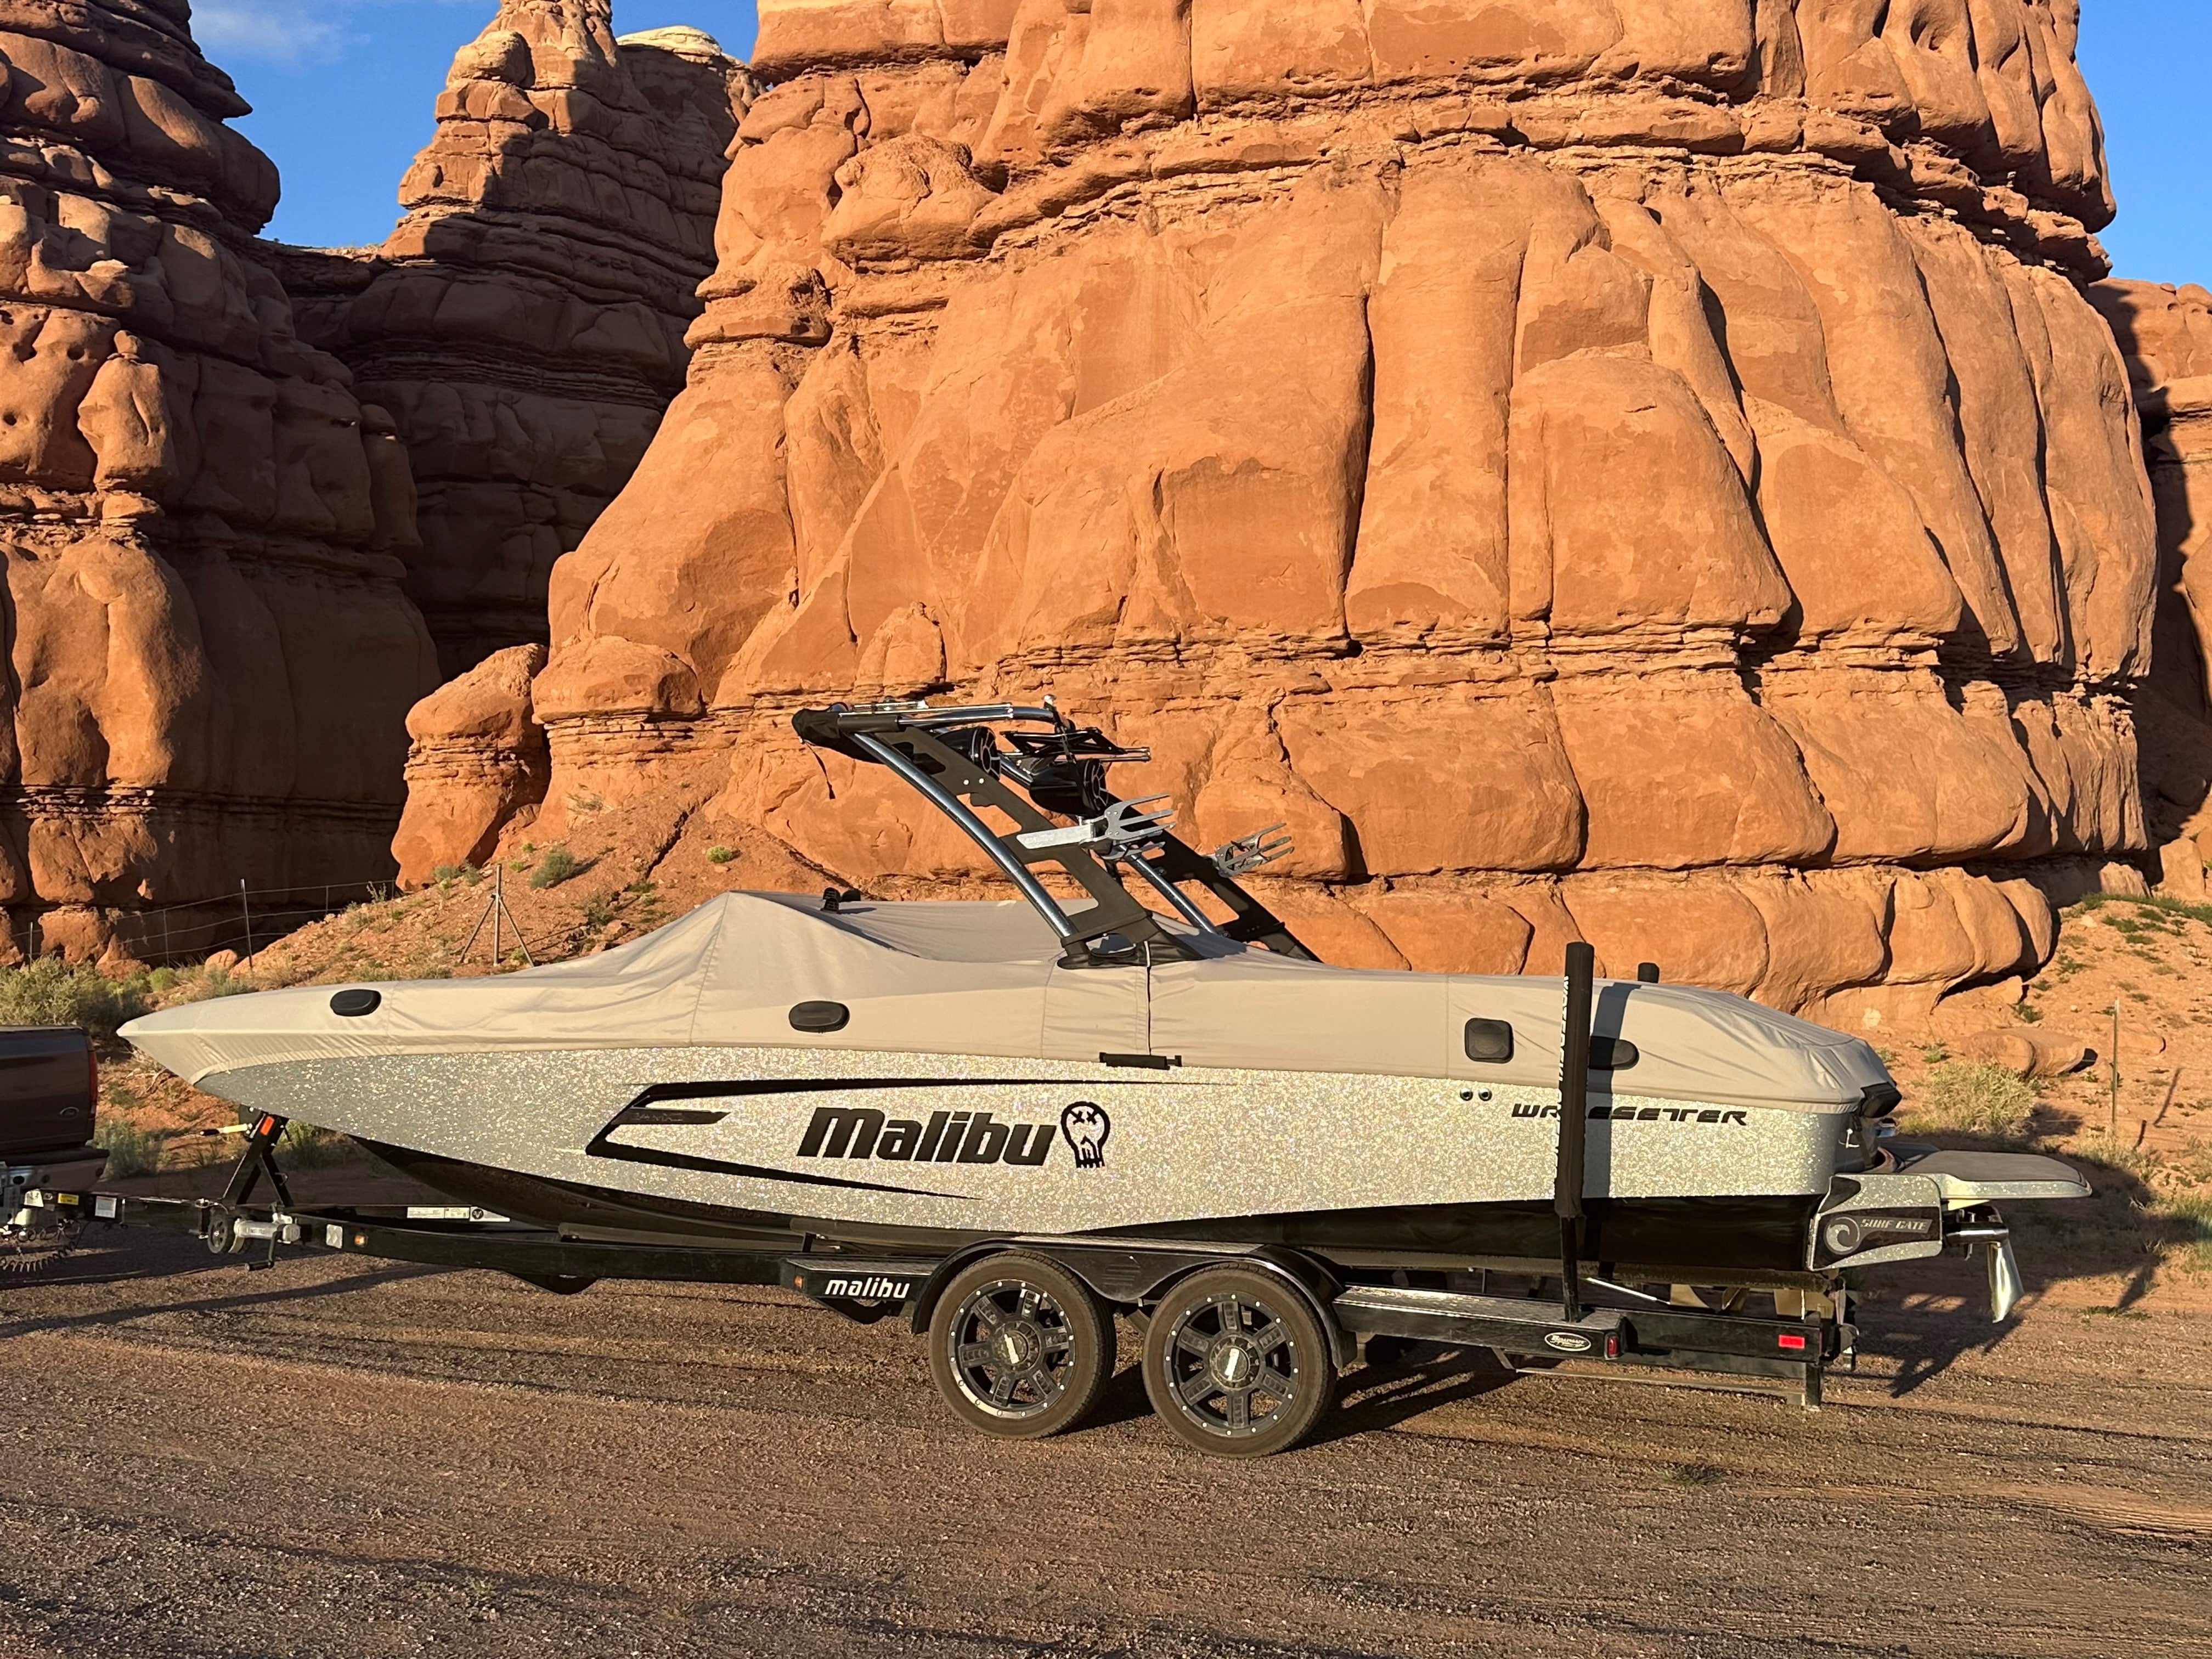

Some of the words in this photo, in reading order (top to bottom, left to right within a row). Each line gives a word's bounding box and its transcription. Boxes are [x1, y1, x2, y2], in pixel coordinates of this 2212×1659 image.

[1511, 1103, 1747, 1126] WAESETTER
[796, 1107, 1057, 1166] Malibu
[1860, 1219, 1894, 1228] SURF
[1895, 1221, 1928, 1230] GATE
[825, 1277, 910, 1299] malibu
